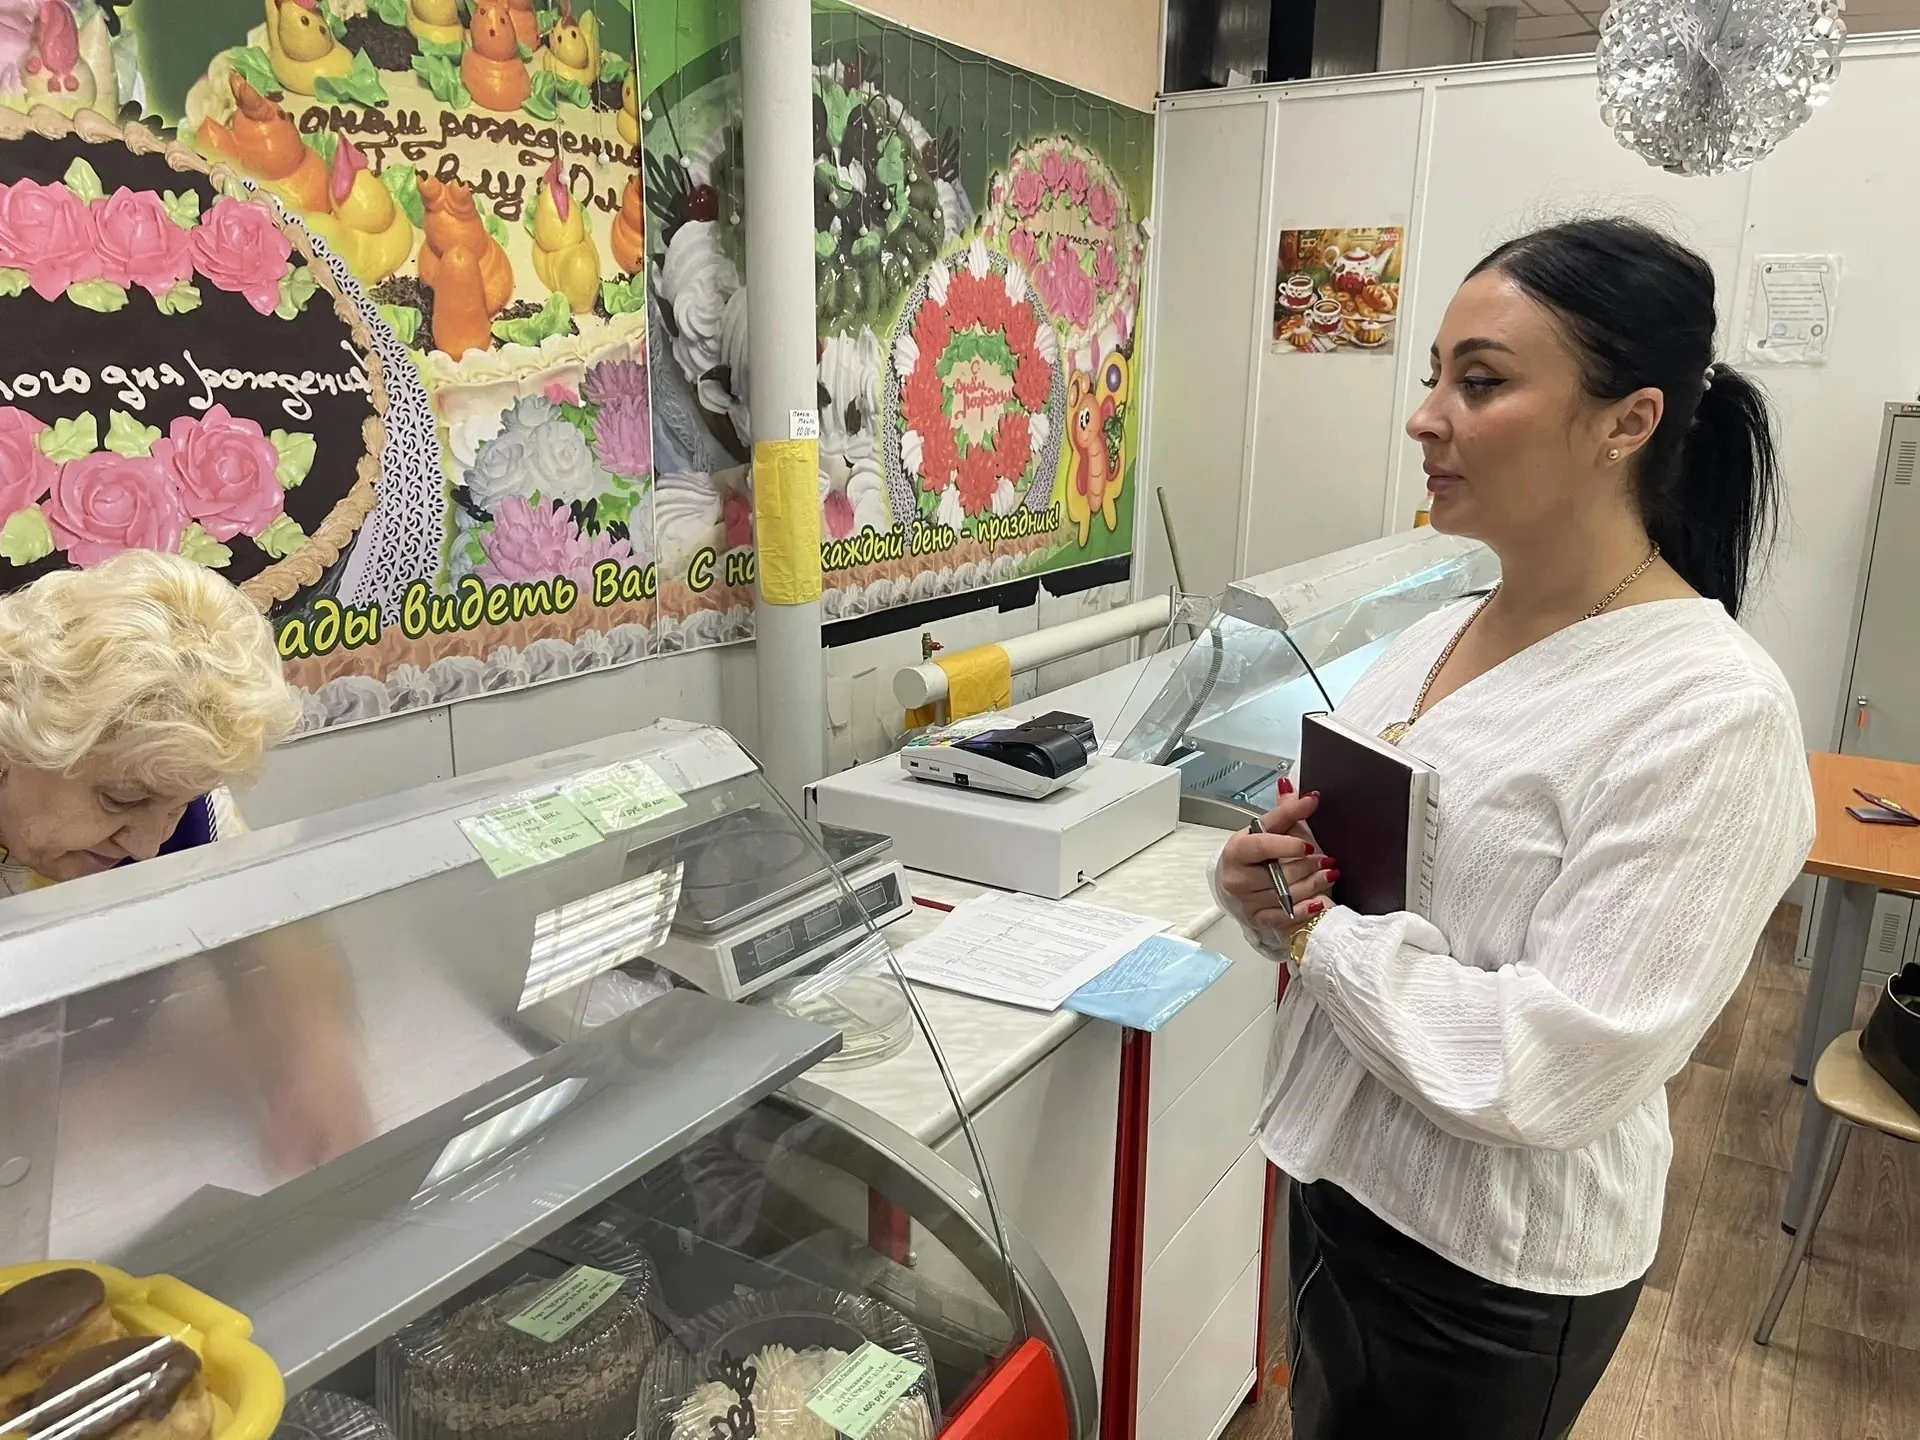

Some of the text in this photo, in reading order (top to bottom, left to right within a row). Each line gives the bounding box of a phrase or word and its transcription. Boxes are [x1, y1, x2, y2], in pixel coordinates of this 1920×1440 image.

[820, 524, 904, 568] каждый
[912, 520, 954, 555] день
[978, 502, 1061, 551] праздник!
[689, 549, 715, 591] С
[277, 598, 378, 657] ады
[402, 577, 577, 637] видеть
[515, 810, 562, 830] КАРТШКА
[874, 1389, 889, 1403] руб.
